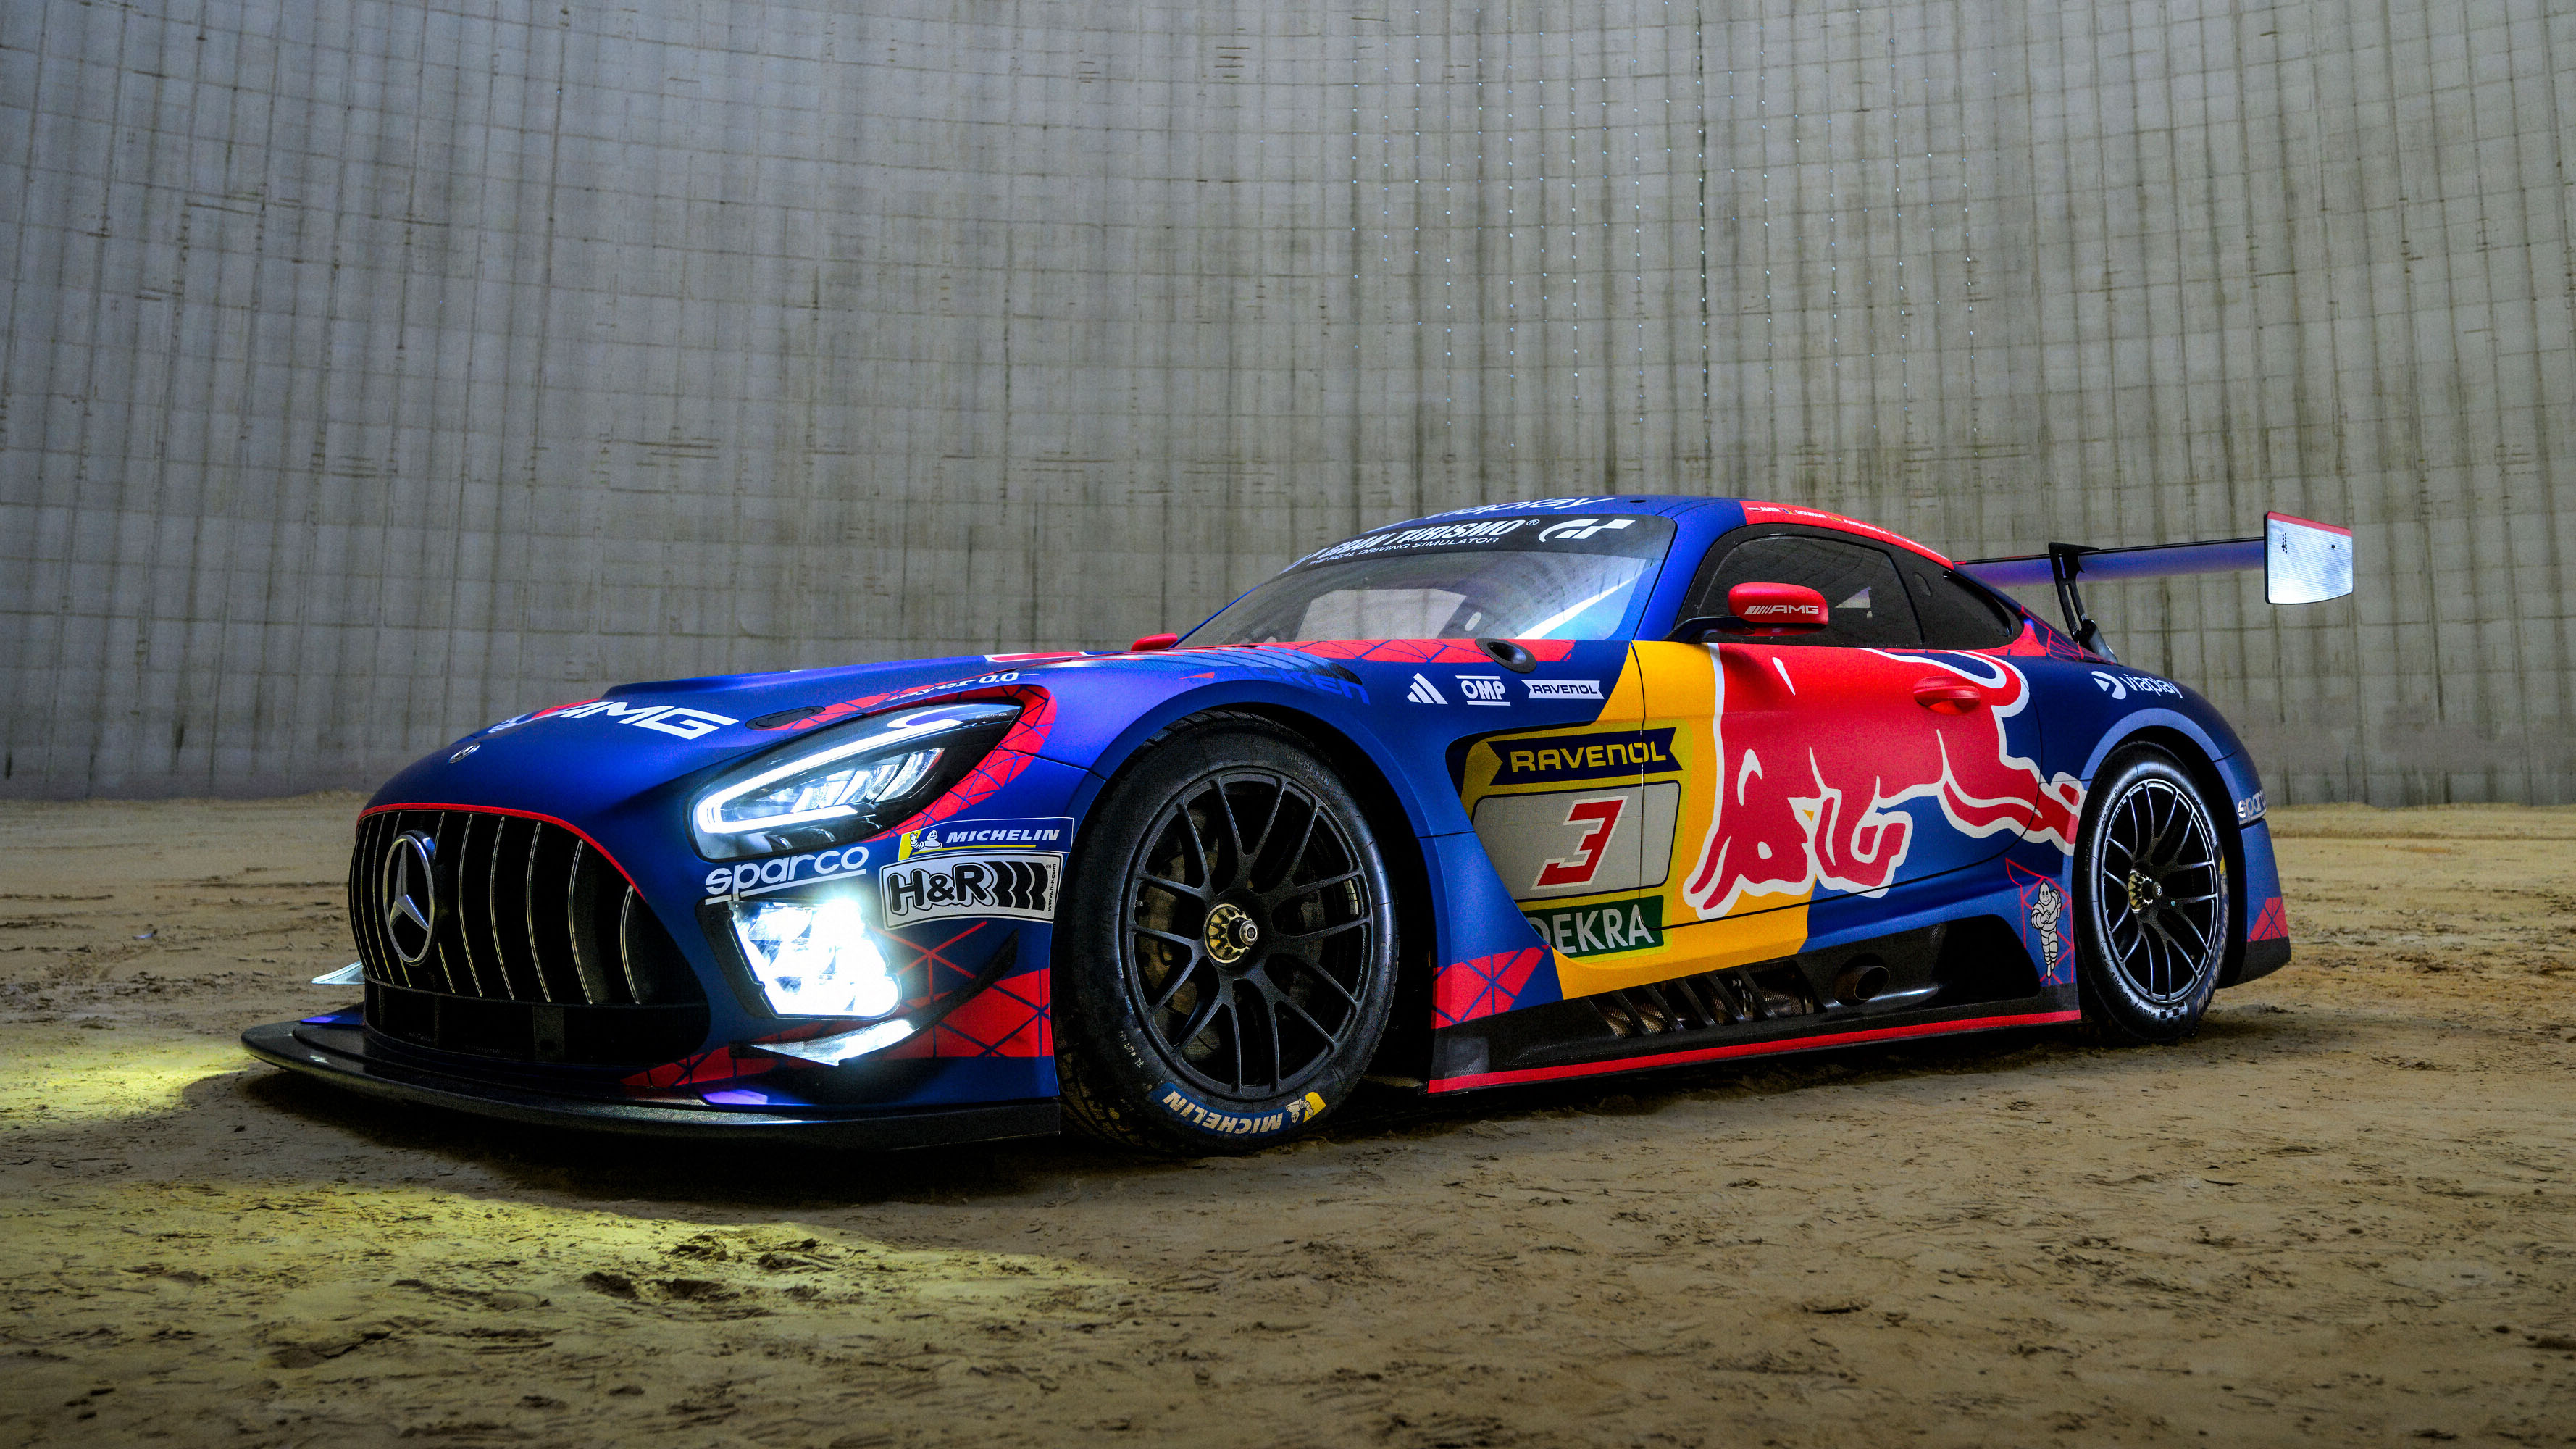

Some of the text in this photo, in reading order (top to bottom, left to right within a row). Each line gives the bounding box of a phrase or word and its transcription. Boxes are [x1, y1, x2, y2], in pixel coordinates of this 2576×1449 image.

[1317, 533, 1397, 559] GRAN
[1327, 551, 1355, 561] REAL
[1358, 543, 1410, 555] DRIVING
[1412, 537, 1500, 548] SIMULATOR
[1768, 605, 1819, 614] AMG
[979, 672, 1019, 683] 0.0
[1460, 680, 1505, 700] OMP
[1531, 685, 1598, 694] RAVENOL
[2117, 673, 2183, 699] viaplay
[556, 701, 740, 740] AMG
[1510, 741, 1667, 772] RAVENOL
[946, 829, 1061, 843] MICHELIN
[1530, 796, 1628, 890] 3
[706, 846, 869, 901] sparco
[887, 864, 992, 914] H&R
[1047, 863, 1057, 911] www.h-r.com
[1162, 1090, 1284, 1135] MICHELIN
